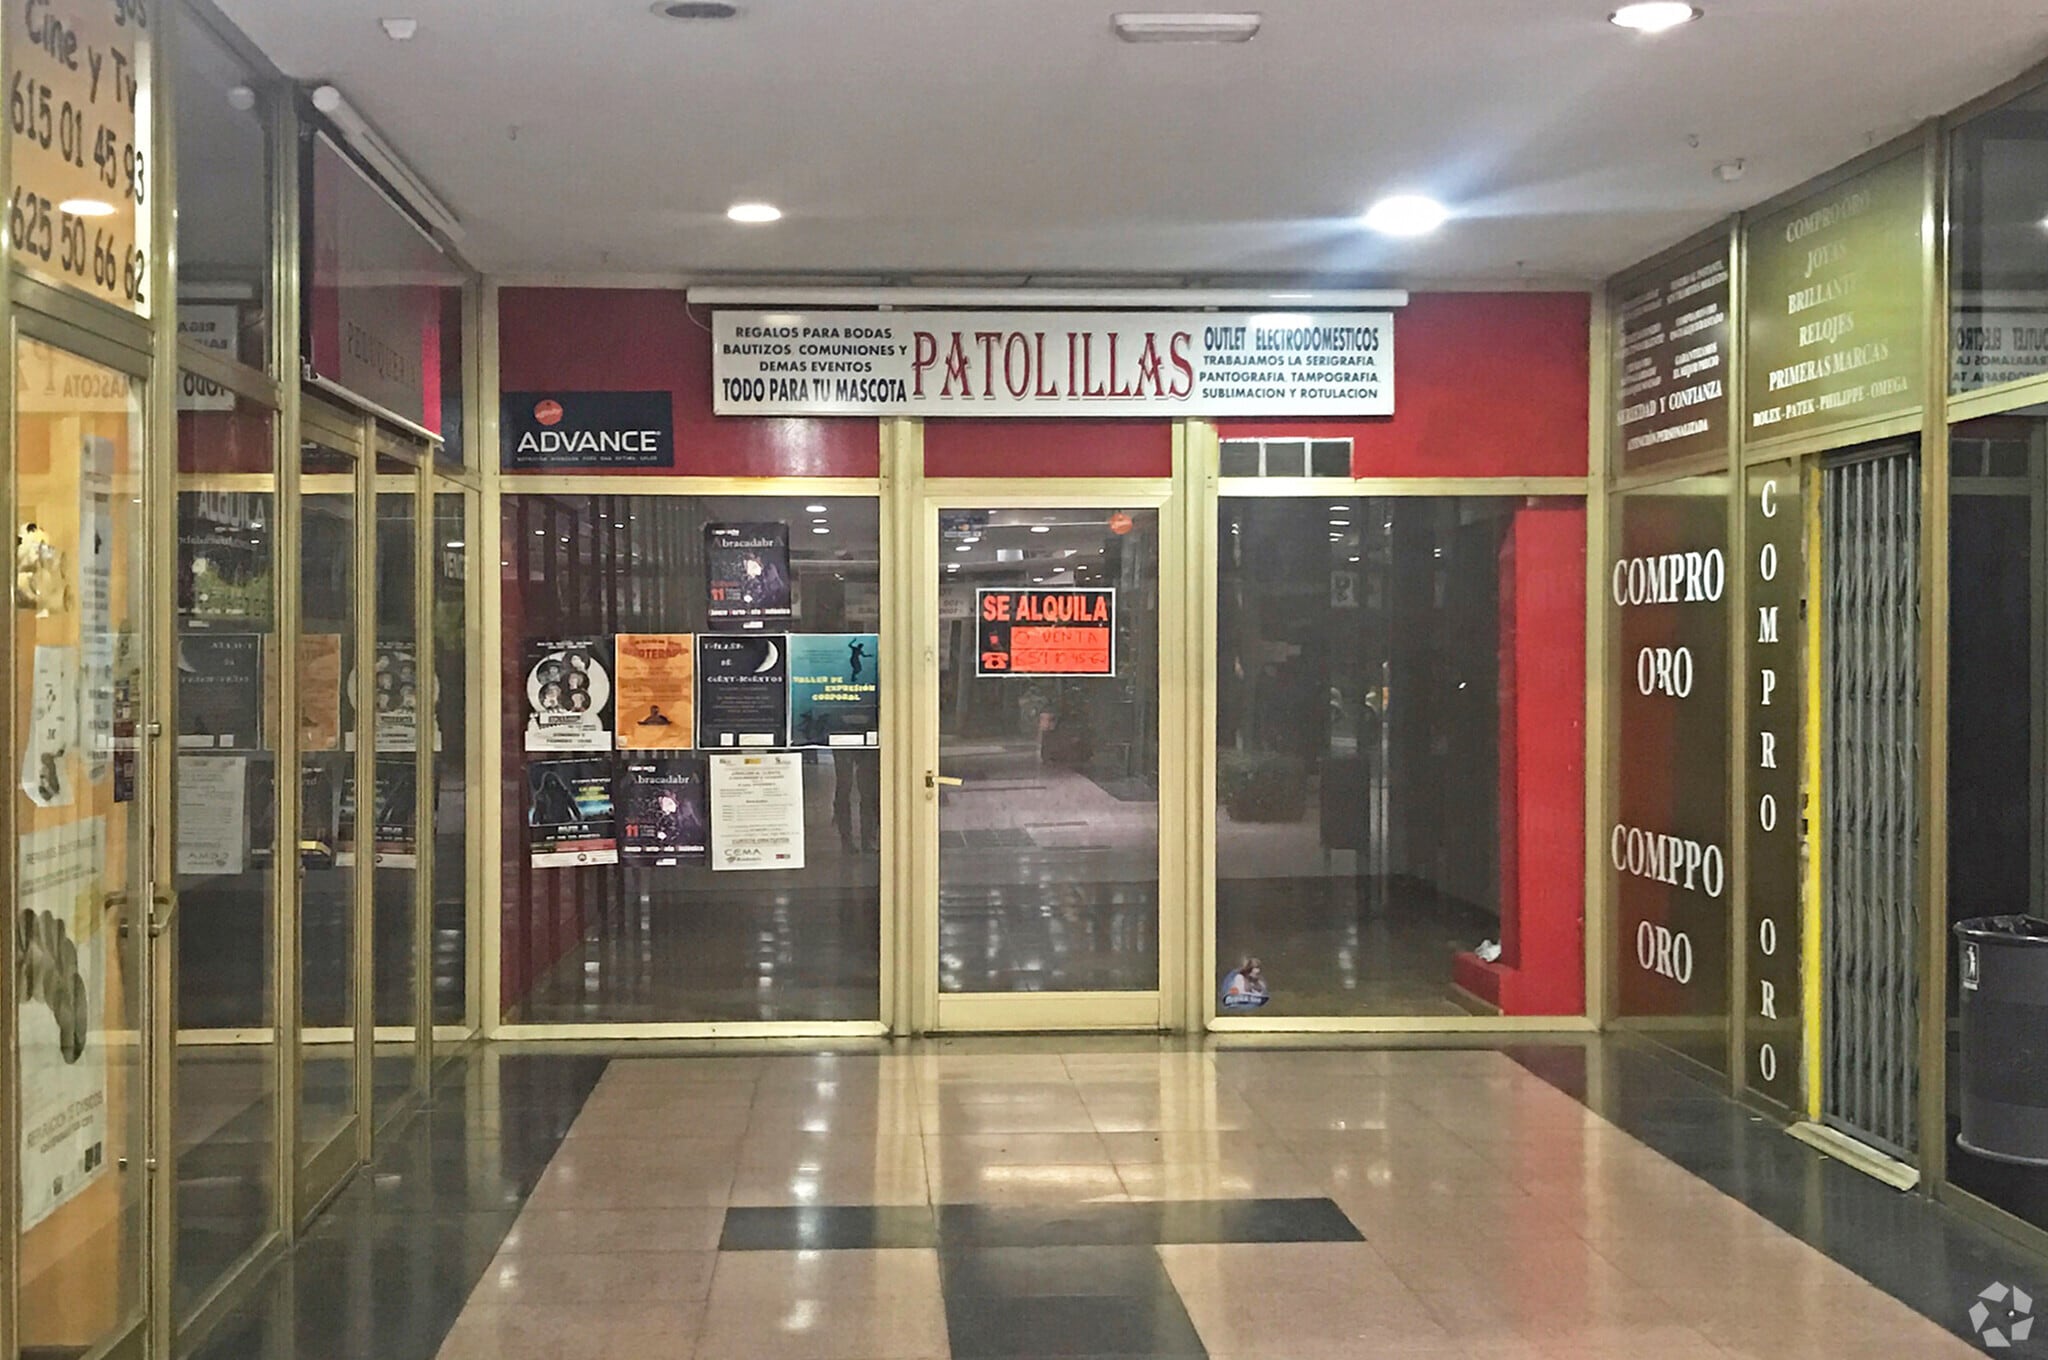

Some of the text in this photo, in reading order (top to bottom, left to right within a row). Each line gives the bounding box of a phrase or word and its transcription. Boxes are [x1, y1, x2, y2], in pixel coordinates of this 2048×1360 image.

[25, 0, 78, 71] Cine
[11, 70, 145, 205] 615 01 45 93
[11, 185, 145, 304] 625 50 66 62
[736, 326, 892, 339] REGALOS PARA BODAS
[1204, 326, 1380, 351] OUTLET ELECTRODOMESTICOS
[1799, 311, 1855, 347] RELOJES
[723, 344, 908, 356] BAUTIZOS COMUNIONES Y
[759, 361, 872, 373] DEMAS EVENTOS
[911, 331, 1194, 400] PATOLILLAS
[1203, 355, 1284, 367] TRABAJAMOS
[1287, 356, 1303, 367] LA
[722, 377, 908, 402] TODO PARA TU MASCOTA
[1769, 355, 1831, 392] PRIMERAS
[1202, 387, 1378, 399] SUBLIMACION Y ROTULACION
[1668, 379, 1722, 411] CONFIANZA
[1785, 398, 1815, 419] PATEK
[1819, 385, 1866, 411] PHILIPPE
[1870, 375, 1909, 398] OMEGA
[517, 430, 659, 453] ADVANCE
[1612, 548, 1725, 606] COMPRO
[983, 594, 1108, 623] SE ALQUILA
[1638, 646, 1693, 698] ORO
[1758, 480, 1779, 832] COMPRO
[1637, 920, 1693, 984] ORO
[1760, 917, 1777, 1082] ORO
